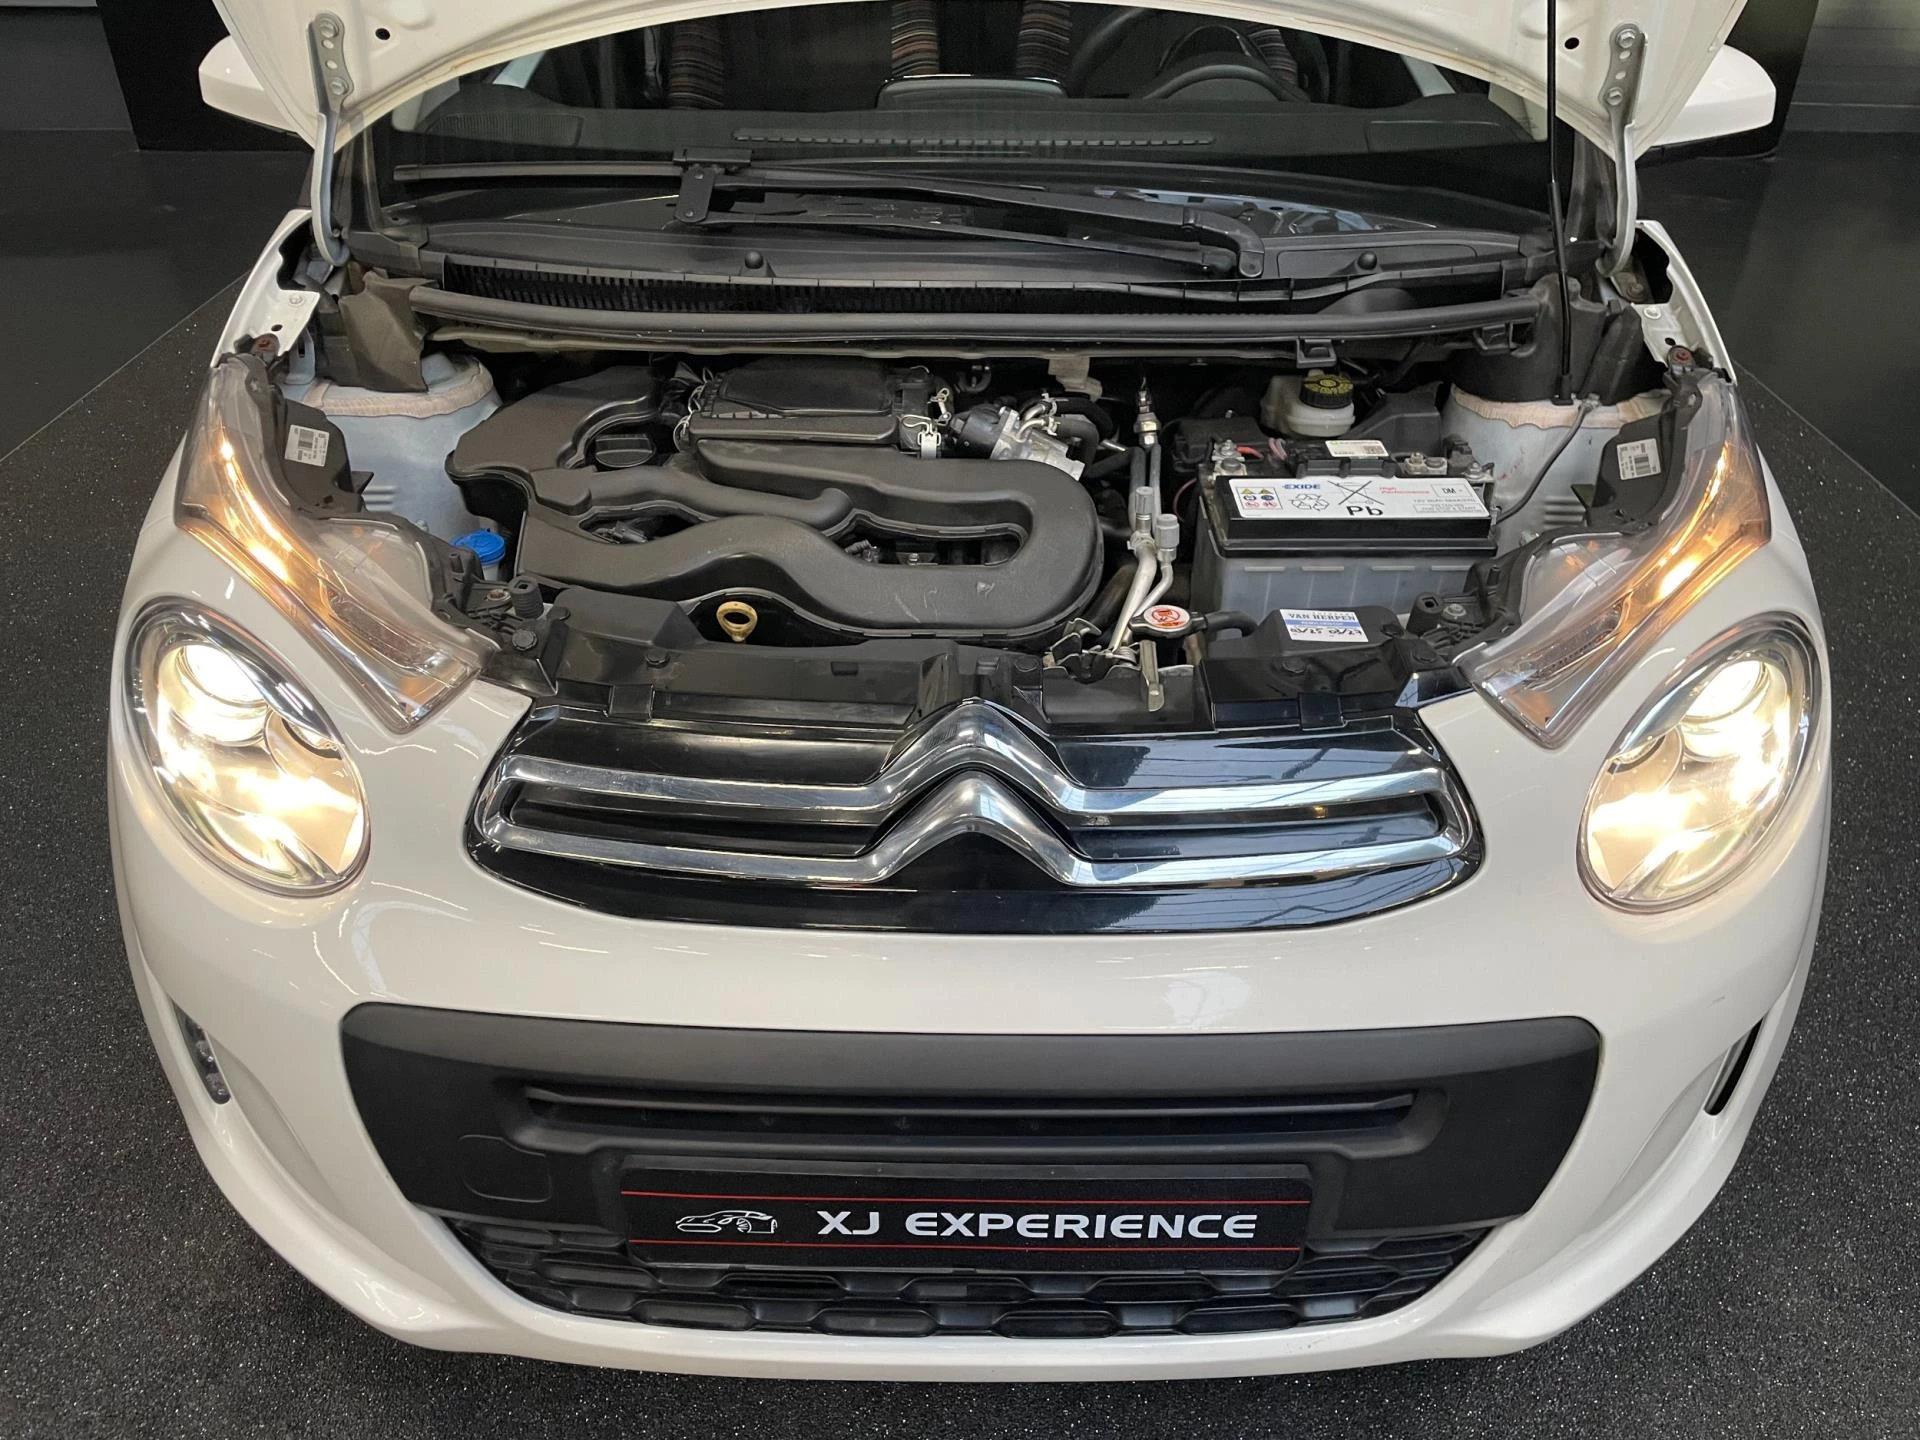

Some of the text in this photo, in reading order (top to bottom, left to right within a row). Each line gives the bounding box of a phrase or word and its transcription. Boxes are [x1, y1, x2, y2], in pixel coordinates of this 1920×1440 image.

[1346, 505, 1384, 516] Pb
[817, 1210, 1259, 1239] XJ EXPERIENCE
